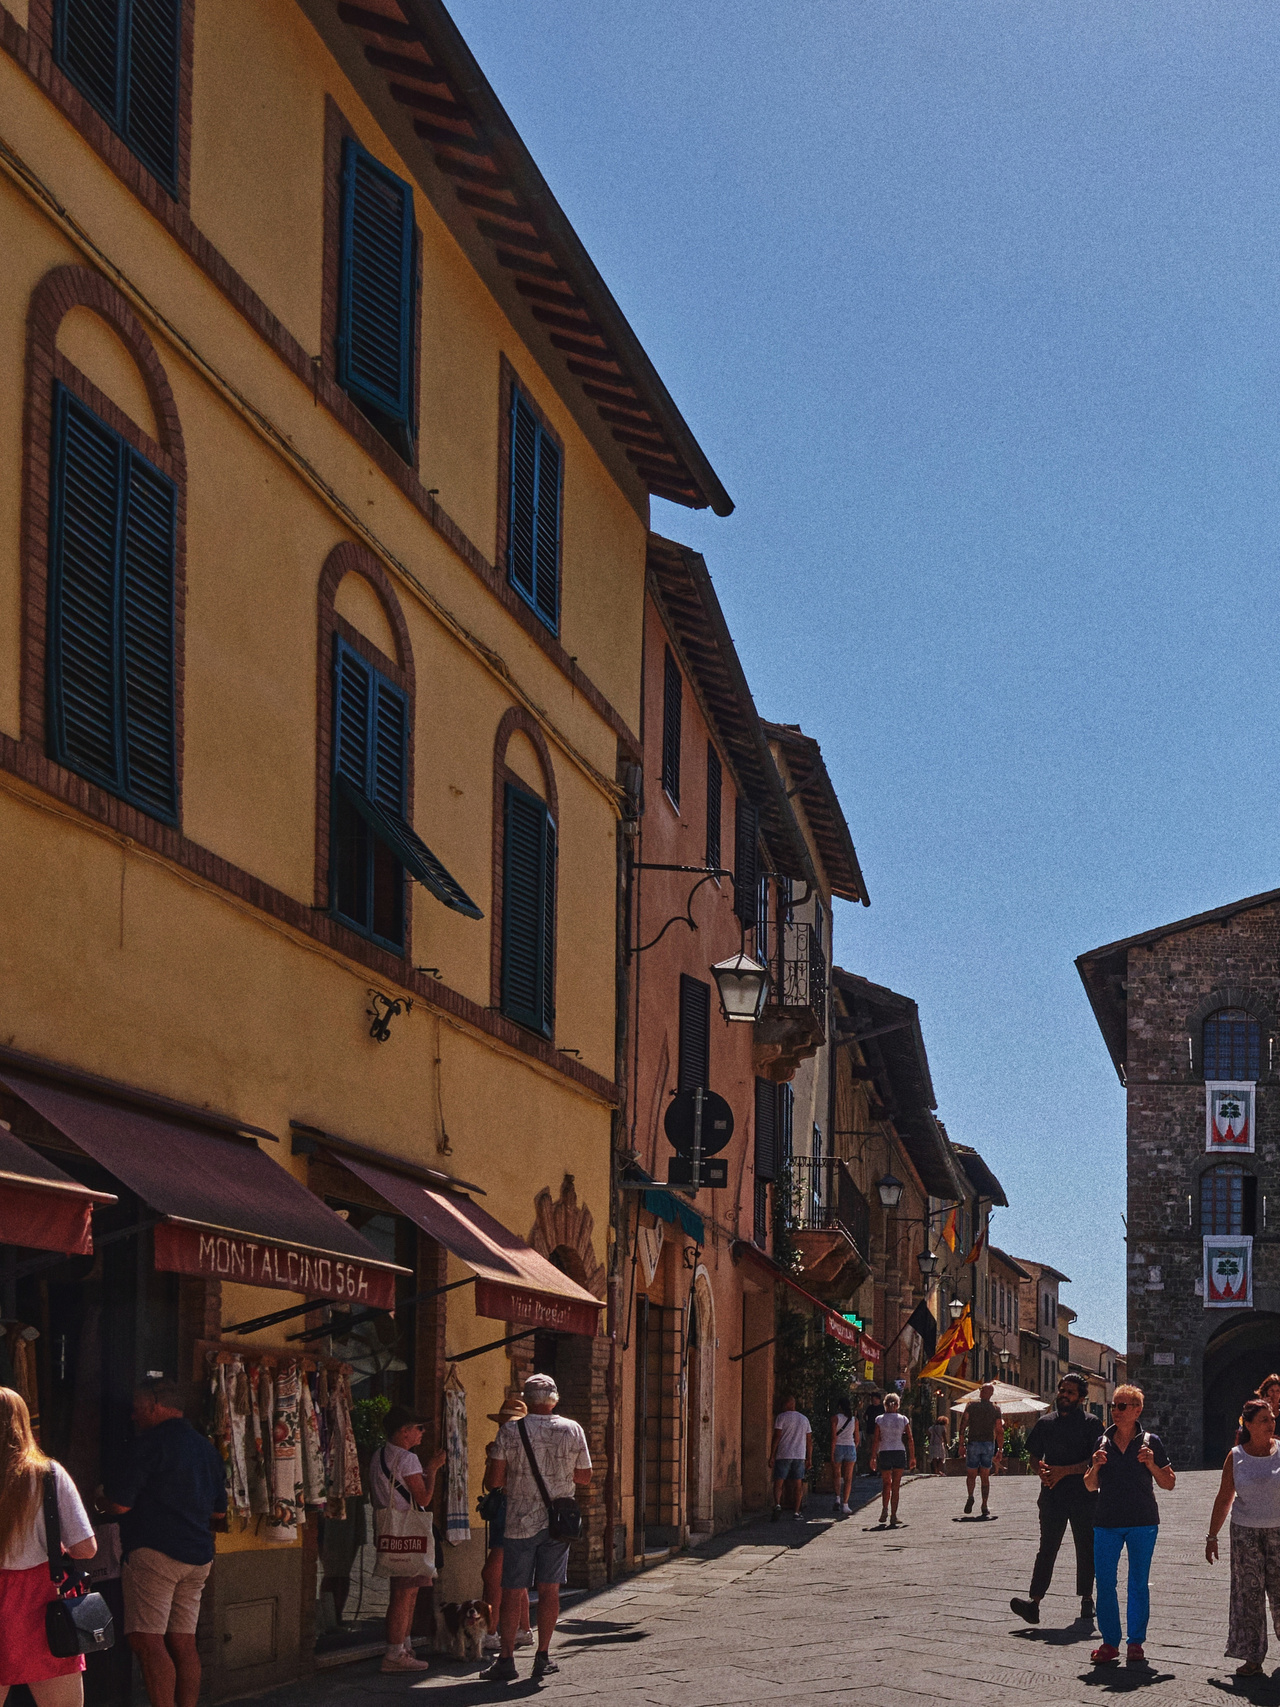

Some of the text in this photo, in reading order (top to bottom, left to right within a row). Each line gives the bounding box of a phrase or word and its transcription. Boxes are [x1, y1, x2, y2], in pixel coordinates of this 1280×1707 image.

[199, 1233, 332, 1292] MONTALCINO
[511, 1295, 532, 1317] Vini
[390, 1538, 421, 1550] BIG STAR
